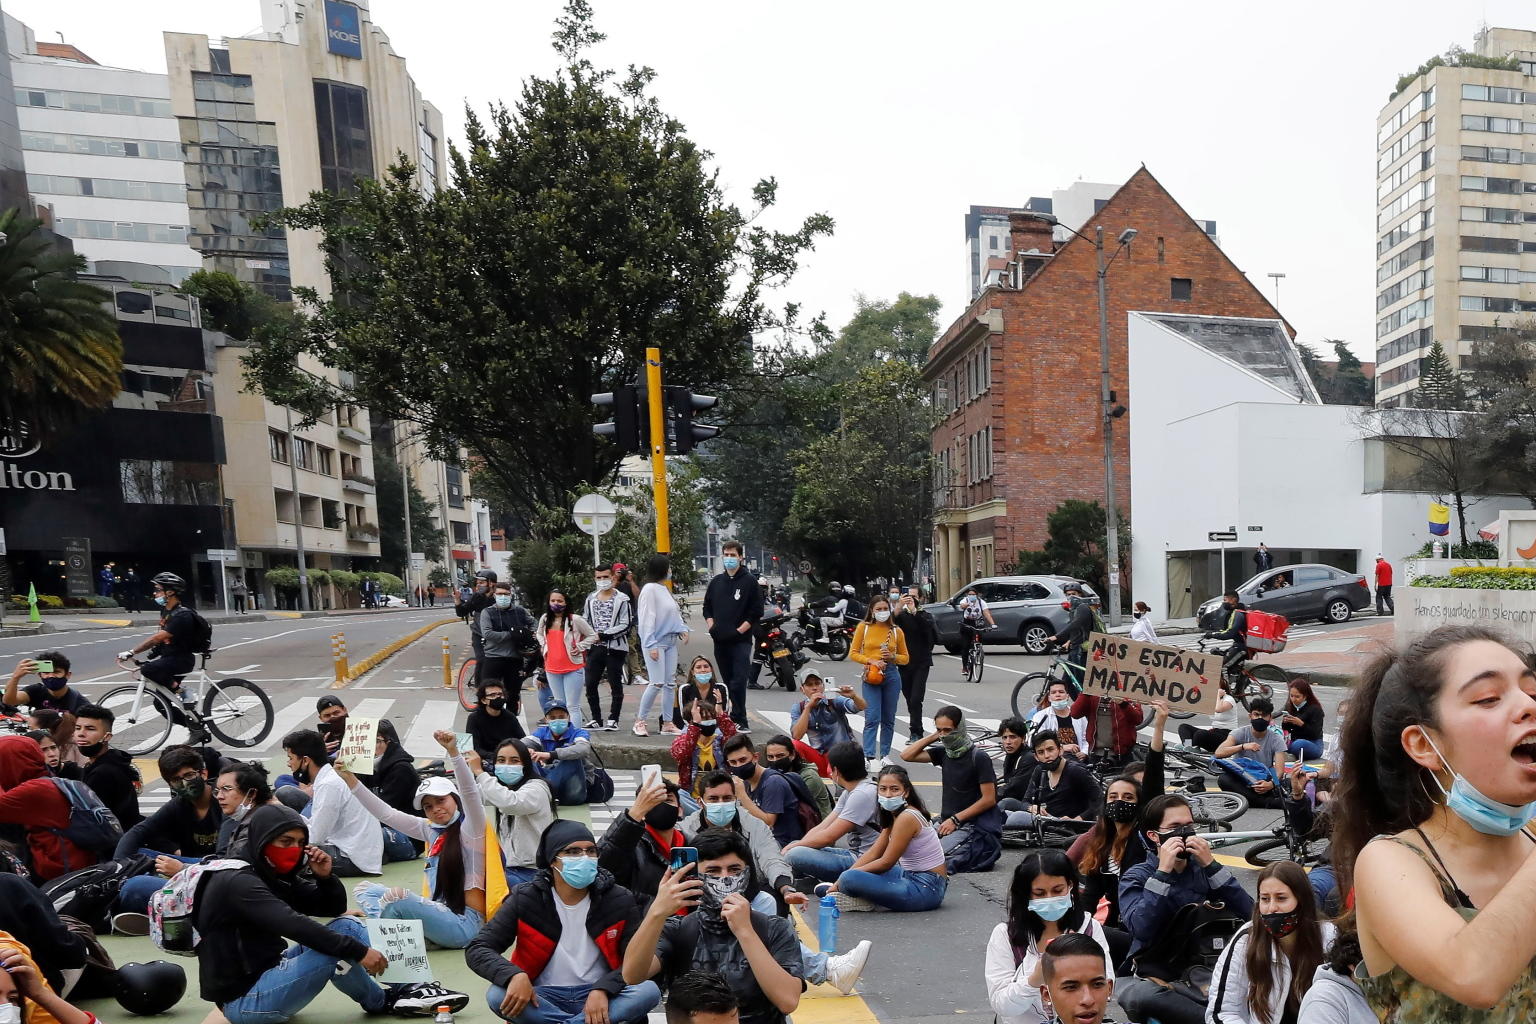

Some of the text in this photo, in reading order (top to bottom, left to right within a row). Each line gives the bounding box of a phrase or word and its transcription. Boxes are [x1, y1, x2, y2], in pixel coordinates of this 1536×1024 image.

[329, 28, 359, 44] KOE
[1092, 638, 1206, 675] NOS ESTÁN
[1088, 665, 1202, 704] MATANDO
